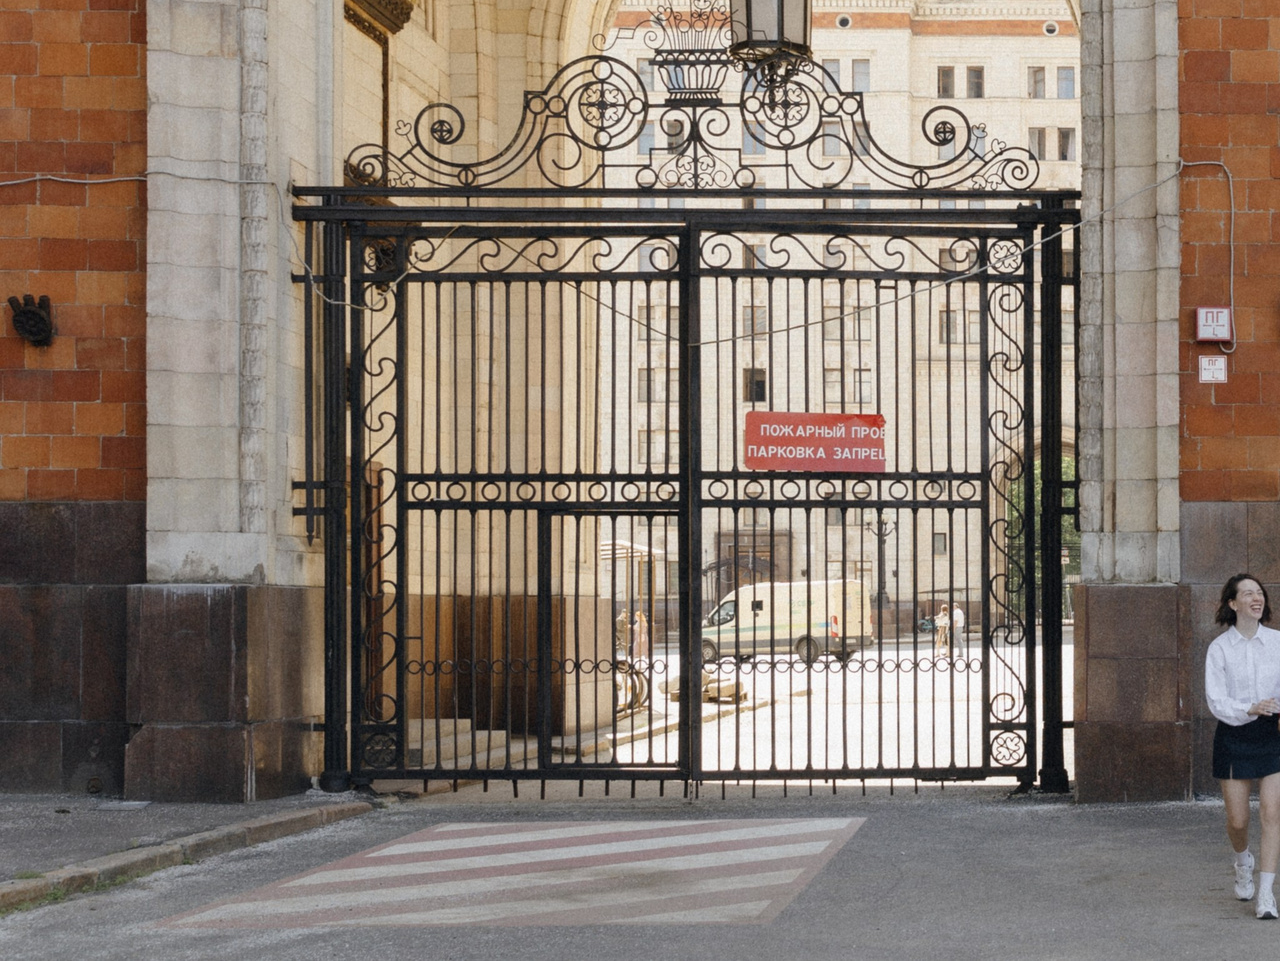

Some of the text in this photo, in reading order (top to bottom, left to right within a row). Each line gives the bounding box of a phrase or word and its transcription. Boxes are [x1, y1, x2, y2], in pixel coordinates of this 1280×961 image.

[1205, 310, 1224, 324] ПГ
[760, 423, 846, 438] ПОЖАРНЫЙ
[747, 445, 826, 459] ПАРКОВКА
